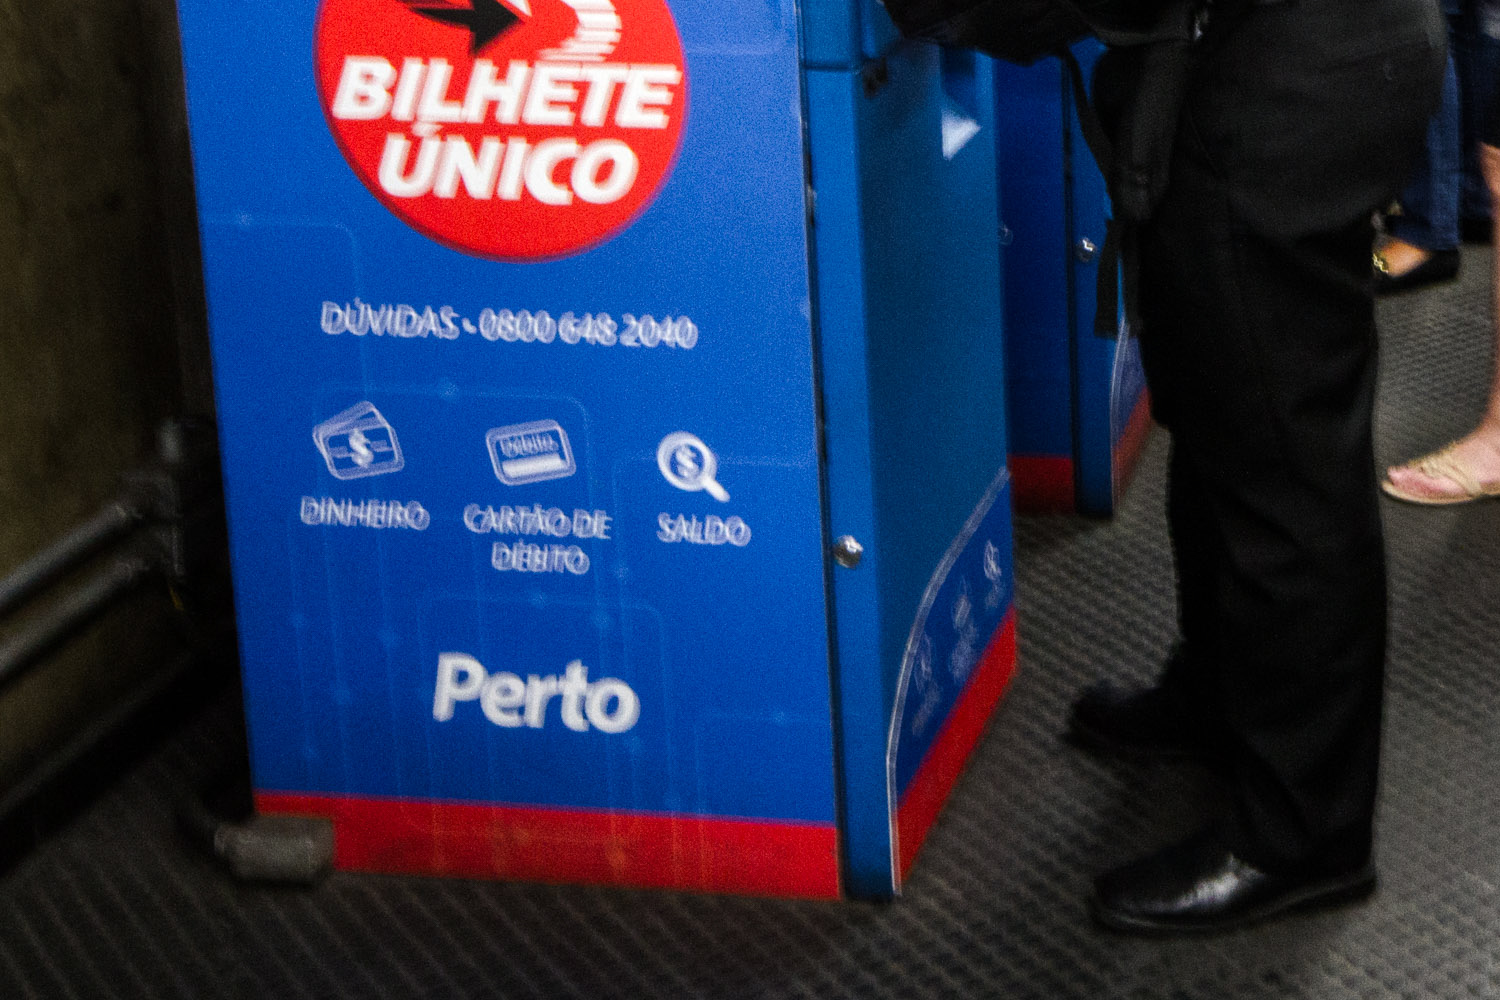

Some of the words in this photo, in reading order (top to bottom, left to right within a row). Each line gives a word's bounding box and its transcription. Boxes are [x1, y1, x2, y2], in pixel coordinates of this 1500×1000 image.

[332, 55, 682, 129] BILHETE
[378, 121, 639, 206] ÚNICO
[320, 297, 460, 340] DÚVIDAS
[479, 308, 557, 343] 0800
[558, 311, 618, 347] 648
[619, 312, 699, 350] 2040
[300, 496, 431, 531] DINHEIRO
[463, 503, 573, 538] CARTÃO
[572, 508, 613, 540] DE
[656, 511, 752, 547] SALDO
[491, 539, 590, 575] DÉBITO
[432, 651, 641, 734] Perto
